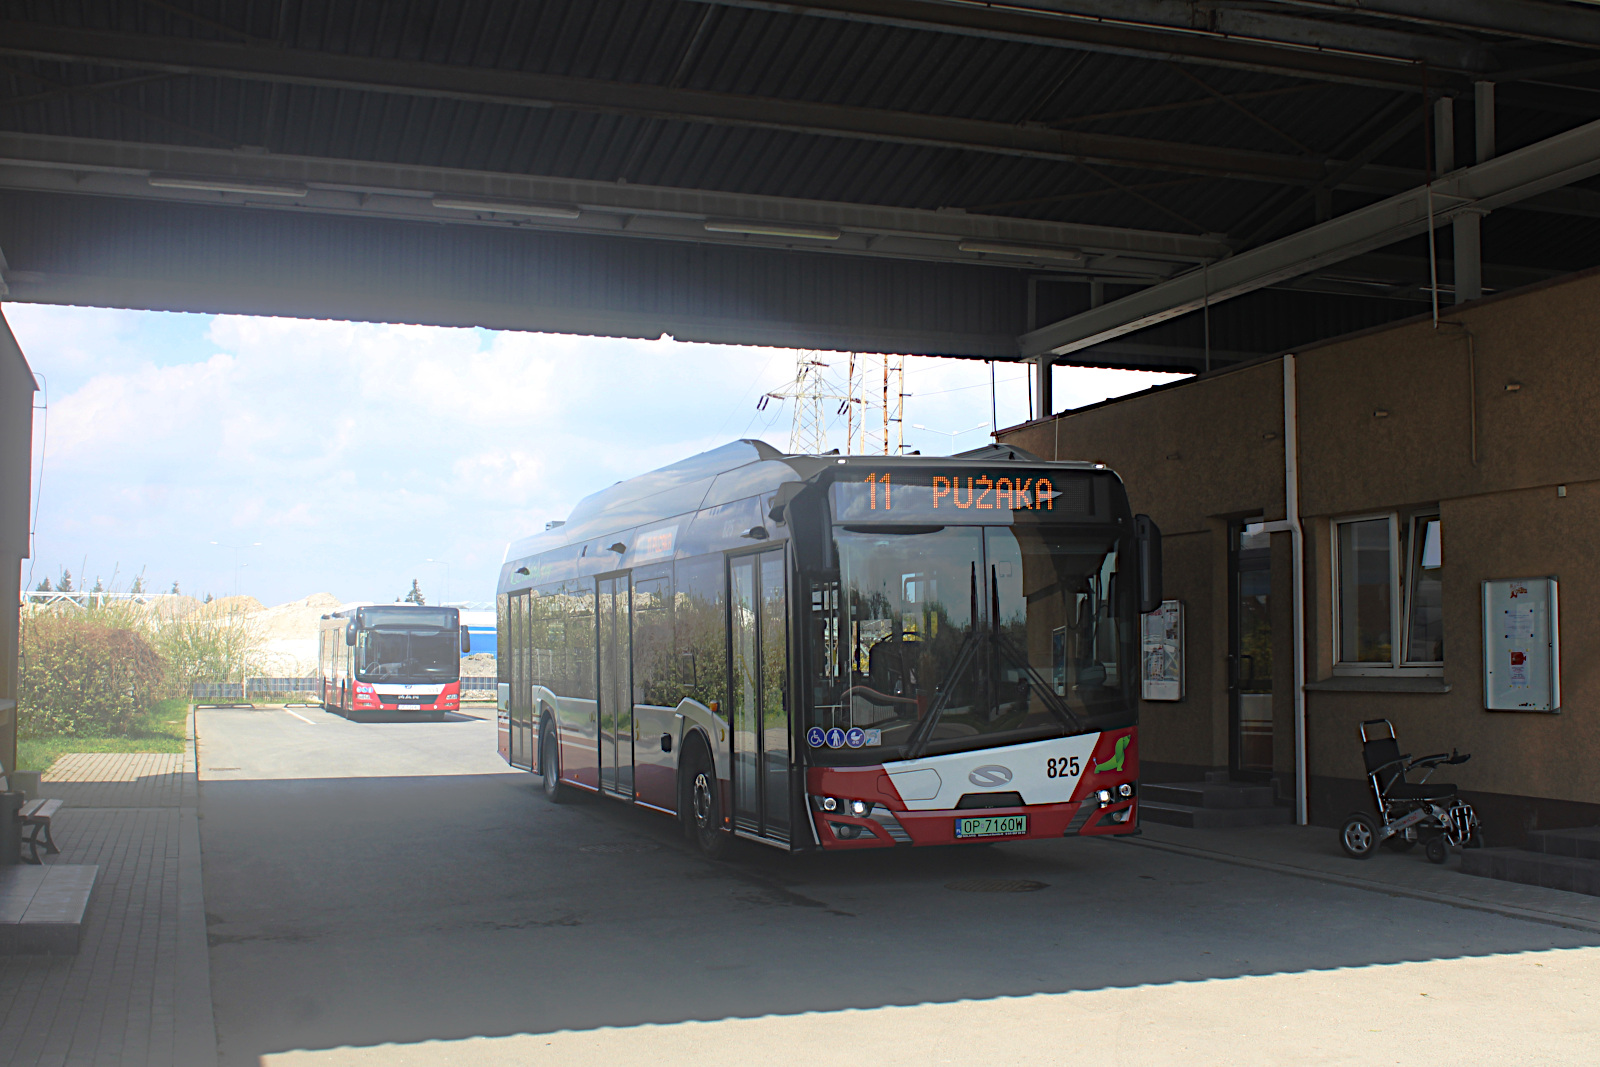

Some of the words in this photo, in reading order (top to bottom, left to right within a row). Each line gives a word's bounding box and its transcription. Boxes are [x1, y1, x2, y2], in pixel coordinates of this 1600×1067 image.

[864, 473, 891, 510] 11
[932, 475, 1053, 510] PUŻAKA
[1047, 756, 1080, 779] 825
[964, 820, 981, 834] OP
[985, 817, 1023, 833] 7160W
